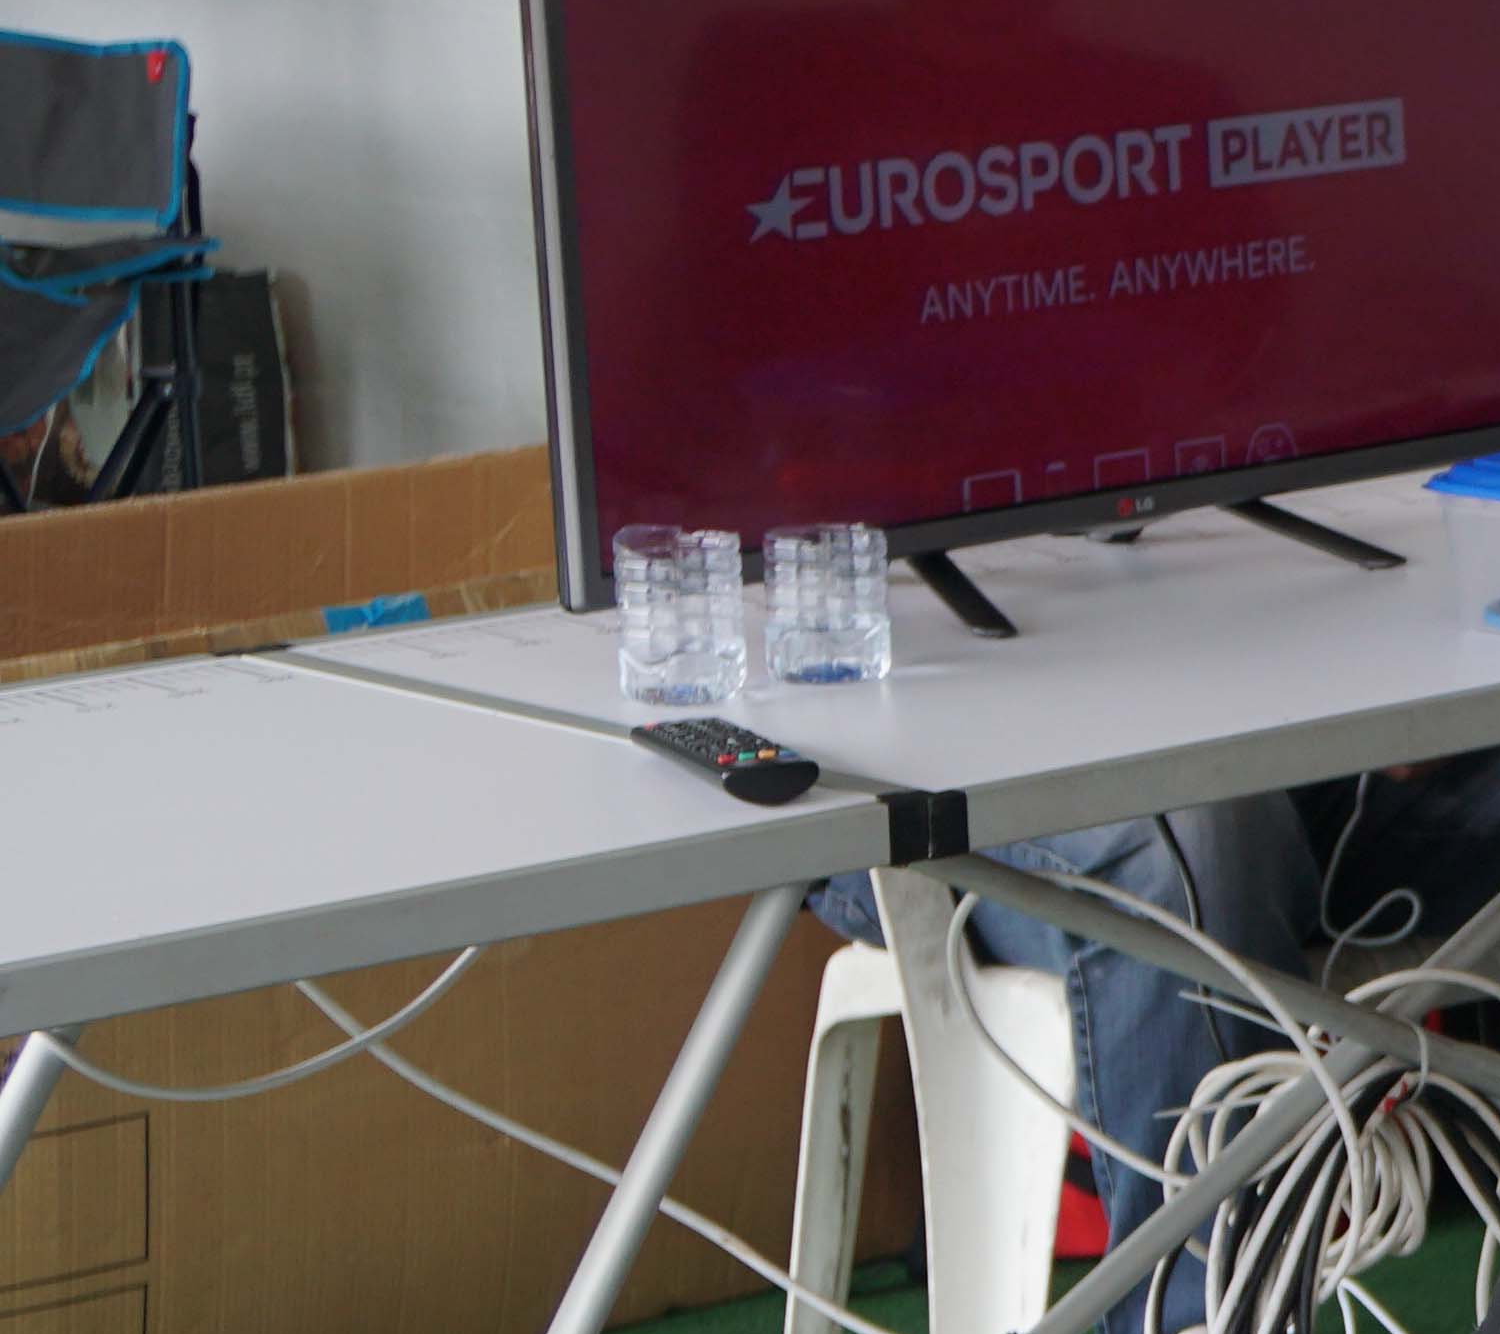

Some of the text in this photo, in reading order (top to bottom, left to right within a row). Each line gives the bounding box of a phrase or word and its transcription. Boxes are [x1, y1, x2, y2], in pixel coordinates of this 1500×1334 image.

[782, 109, 1396, 243] EUROSPORT PLAYER
[920, 234, 1317, 324] ANYTIME. ANYWHERE.
